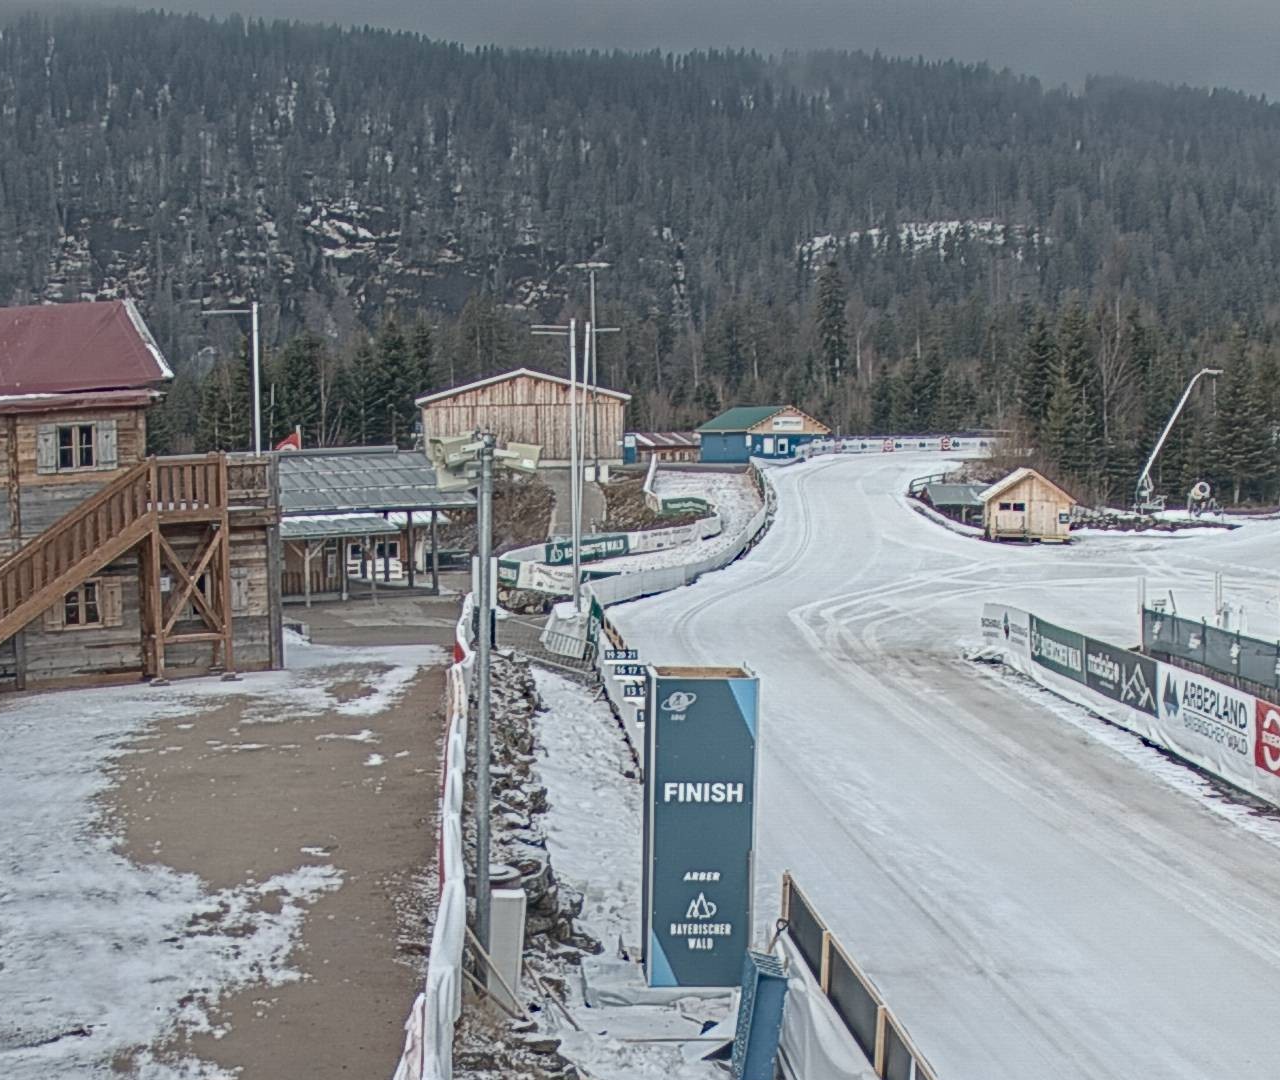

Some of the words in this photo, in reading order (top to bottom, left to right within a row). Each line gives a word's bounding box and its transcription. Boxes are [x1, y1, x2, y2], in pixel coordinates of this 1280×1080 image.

[664, 782, 744, 803] FINISH
[683, 871, 721, 881] ARBER
[670, 924, 732, 936] BAYERISCHER
[688, 938, 714, 950] WALD
